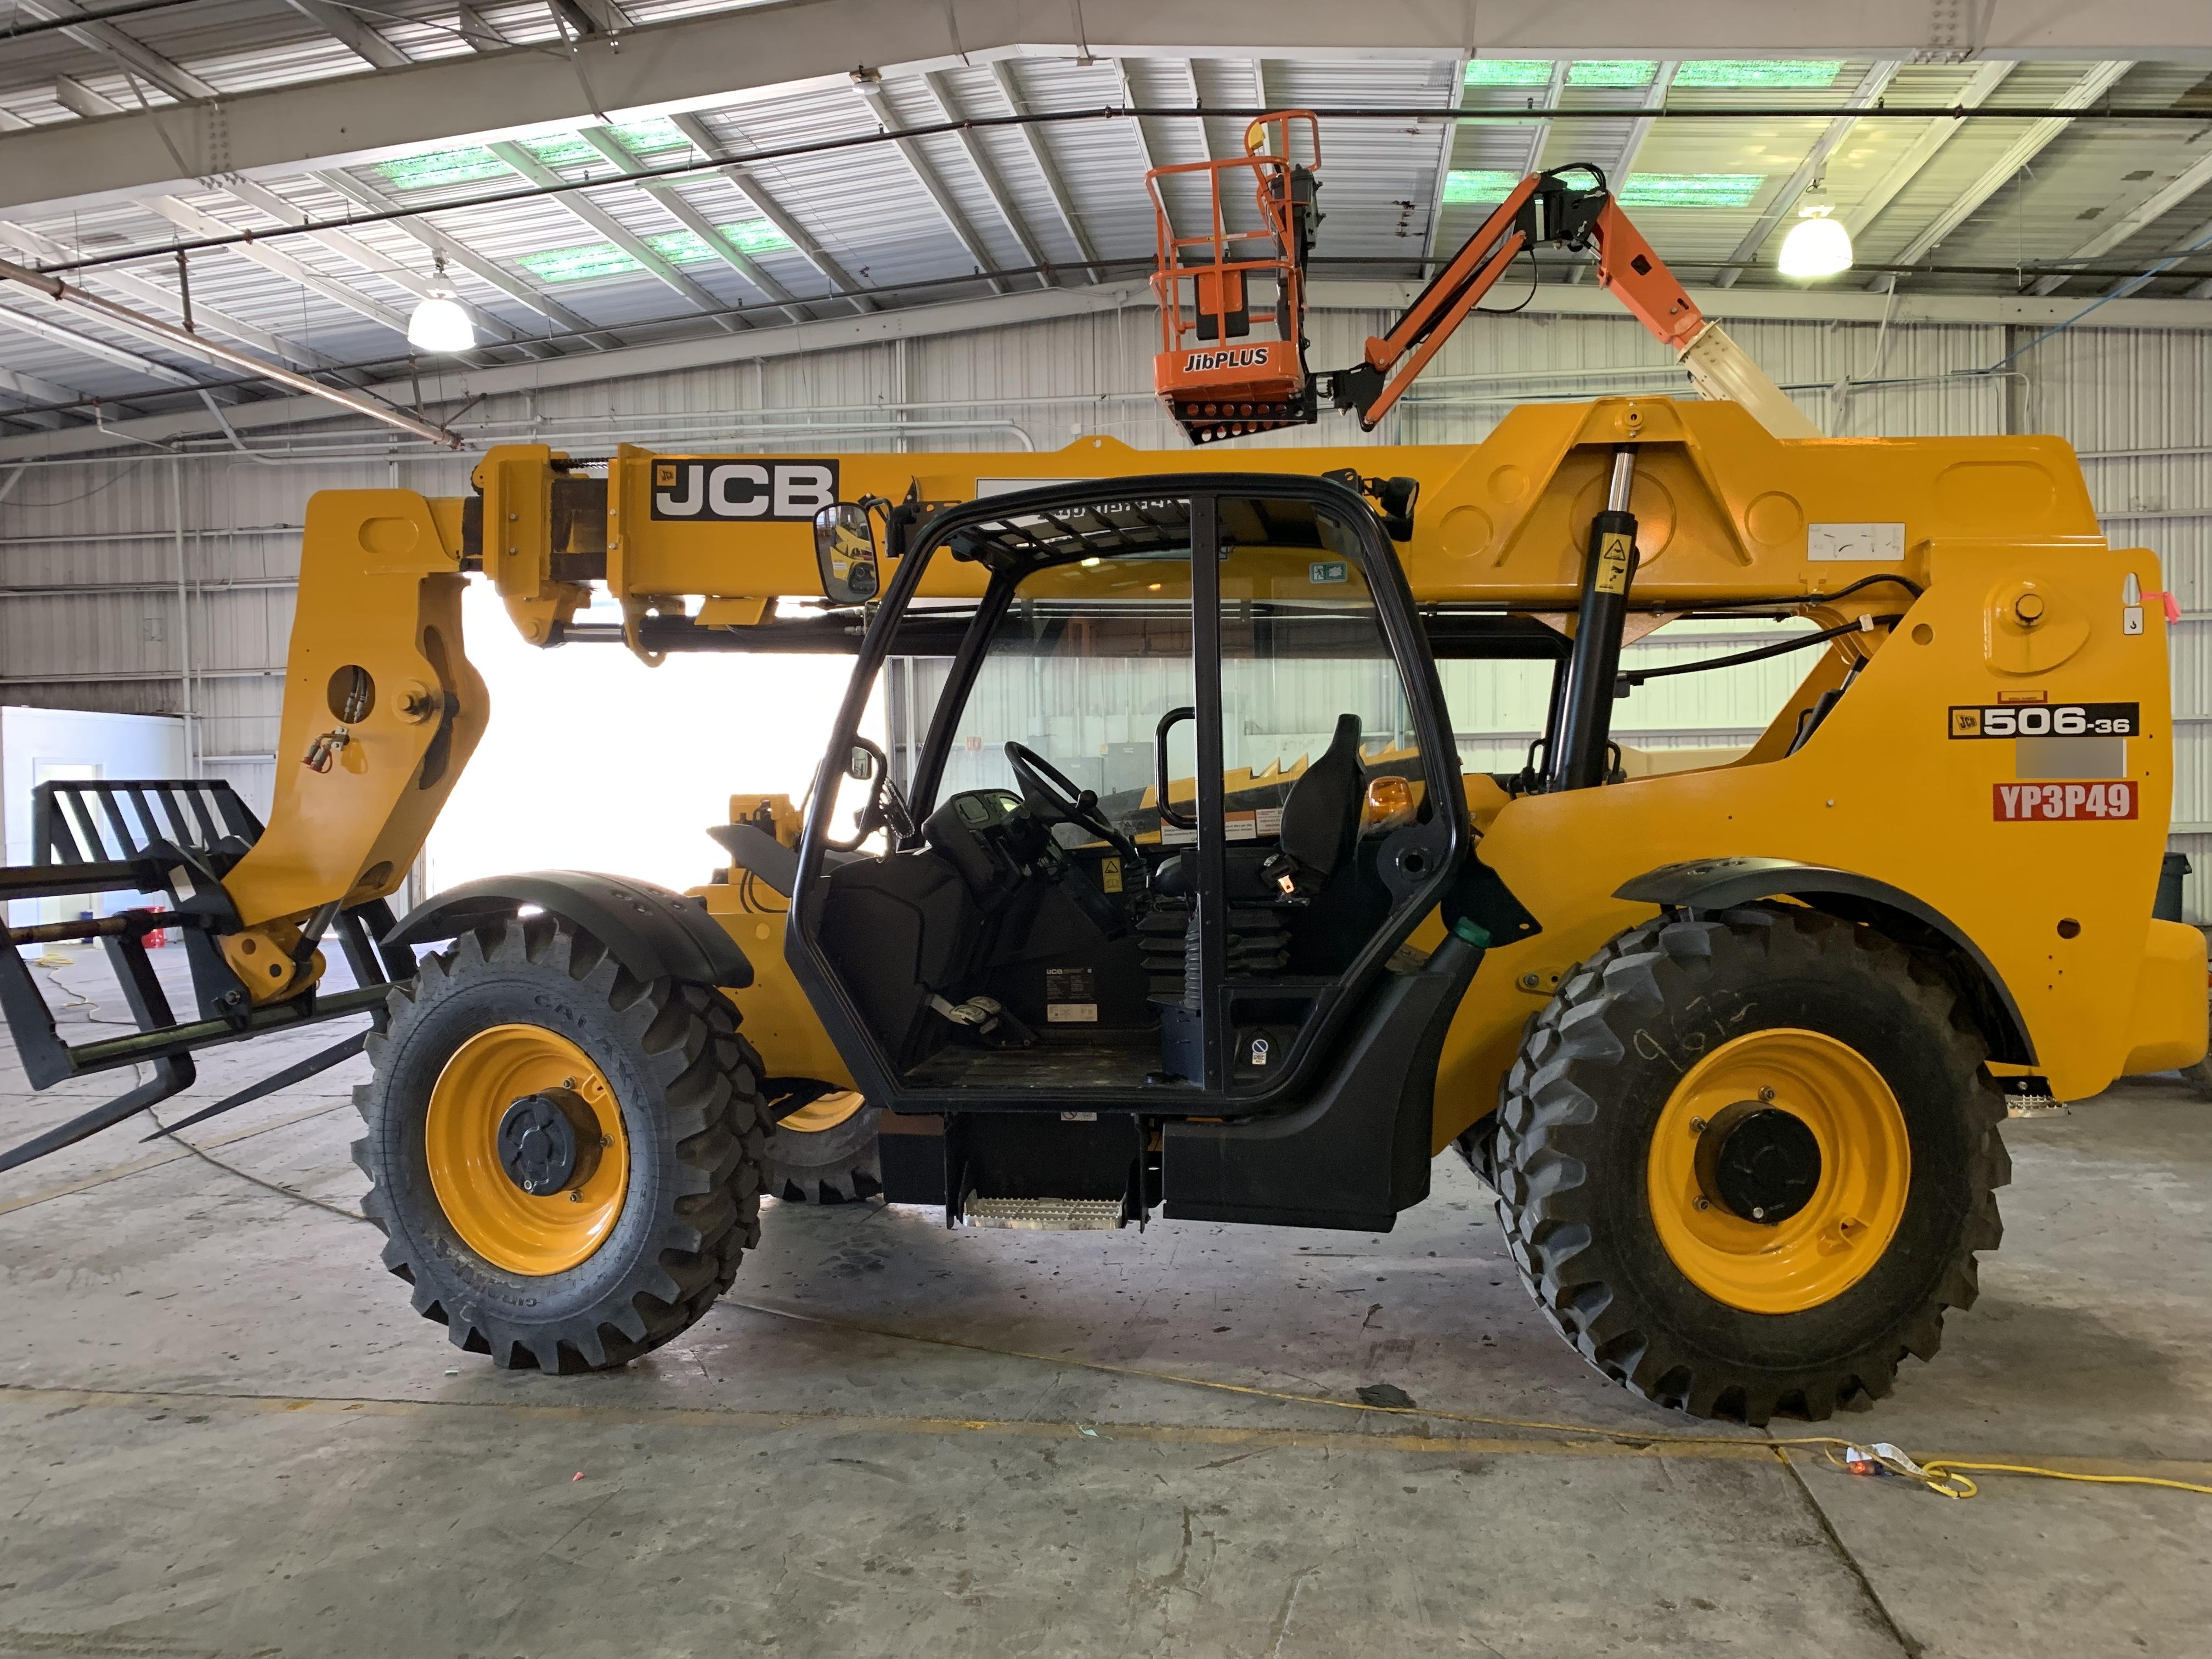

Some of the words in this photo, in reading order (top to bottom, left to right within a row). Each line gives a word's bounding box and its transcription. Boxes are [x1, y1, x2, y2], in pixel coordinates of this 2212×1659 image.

[1184, 348, 1268, 372] JibPLUS
[656, 464, 834, 516] JCB
[1958, 714, 1978, 729] JCB
[1984, 707, 2130, 735] 506-36
[2000, 783, 2130, 818] YP3P49
